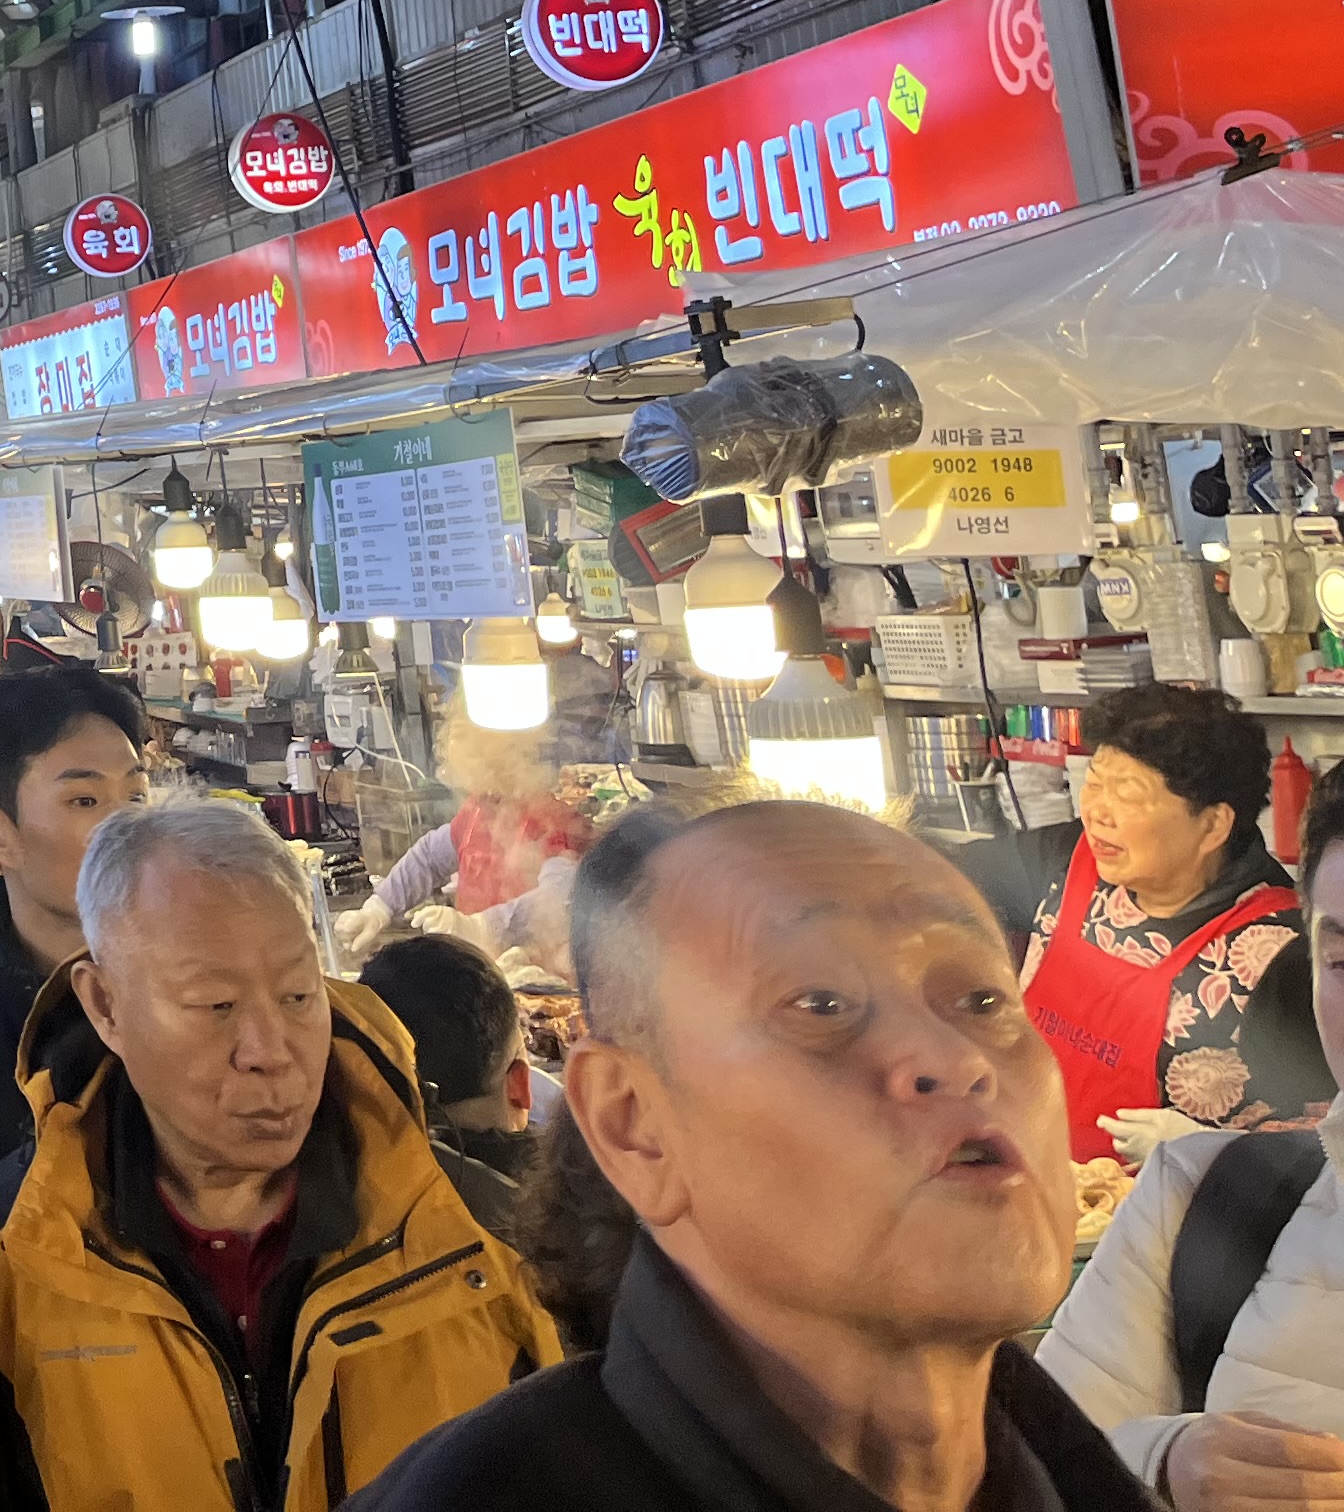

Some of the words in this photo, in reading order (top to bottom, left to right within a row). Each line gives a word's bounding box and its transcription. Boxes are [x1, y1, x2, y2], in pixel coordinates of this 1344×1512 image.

[548, 8, 650, 57] 빈대떡
[245, 145, 329, 177] 모녀김밥
[427, 183, 599, 326] 모녀김밥
[703, 96, 896, 266] 빈대떡
[82, 225, 141, 259] 육회
[357, 237, 372, 256] 197
[185, 289, 277, 378] 모녀김밥
[35, 350, 97, 416] 장미집
[932, 428, 984, 447] 새마을
[990, 427, 1025, 445] 금고
[932, 457, 978, 474] 9002
[991, 456, 1033, 473] 1948
[948, 486, 992, 503] 4026
[1004, 486, 1015, 502] 6
[956, 516, 1010, 536] 나영선
